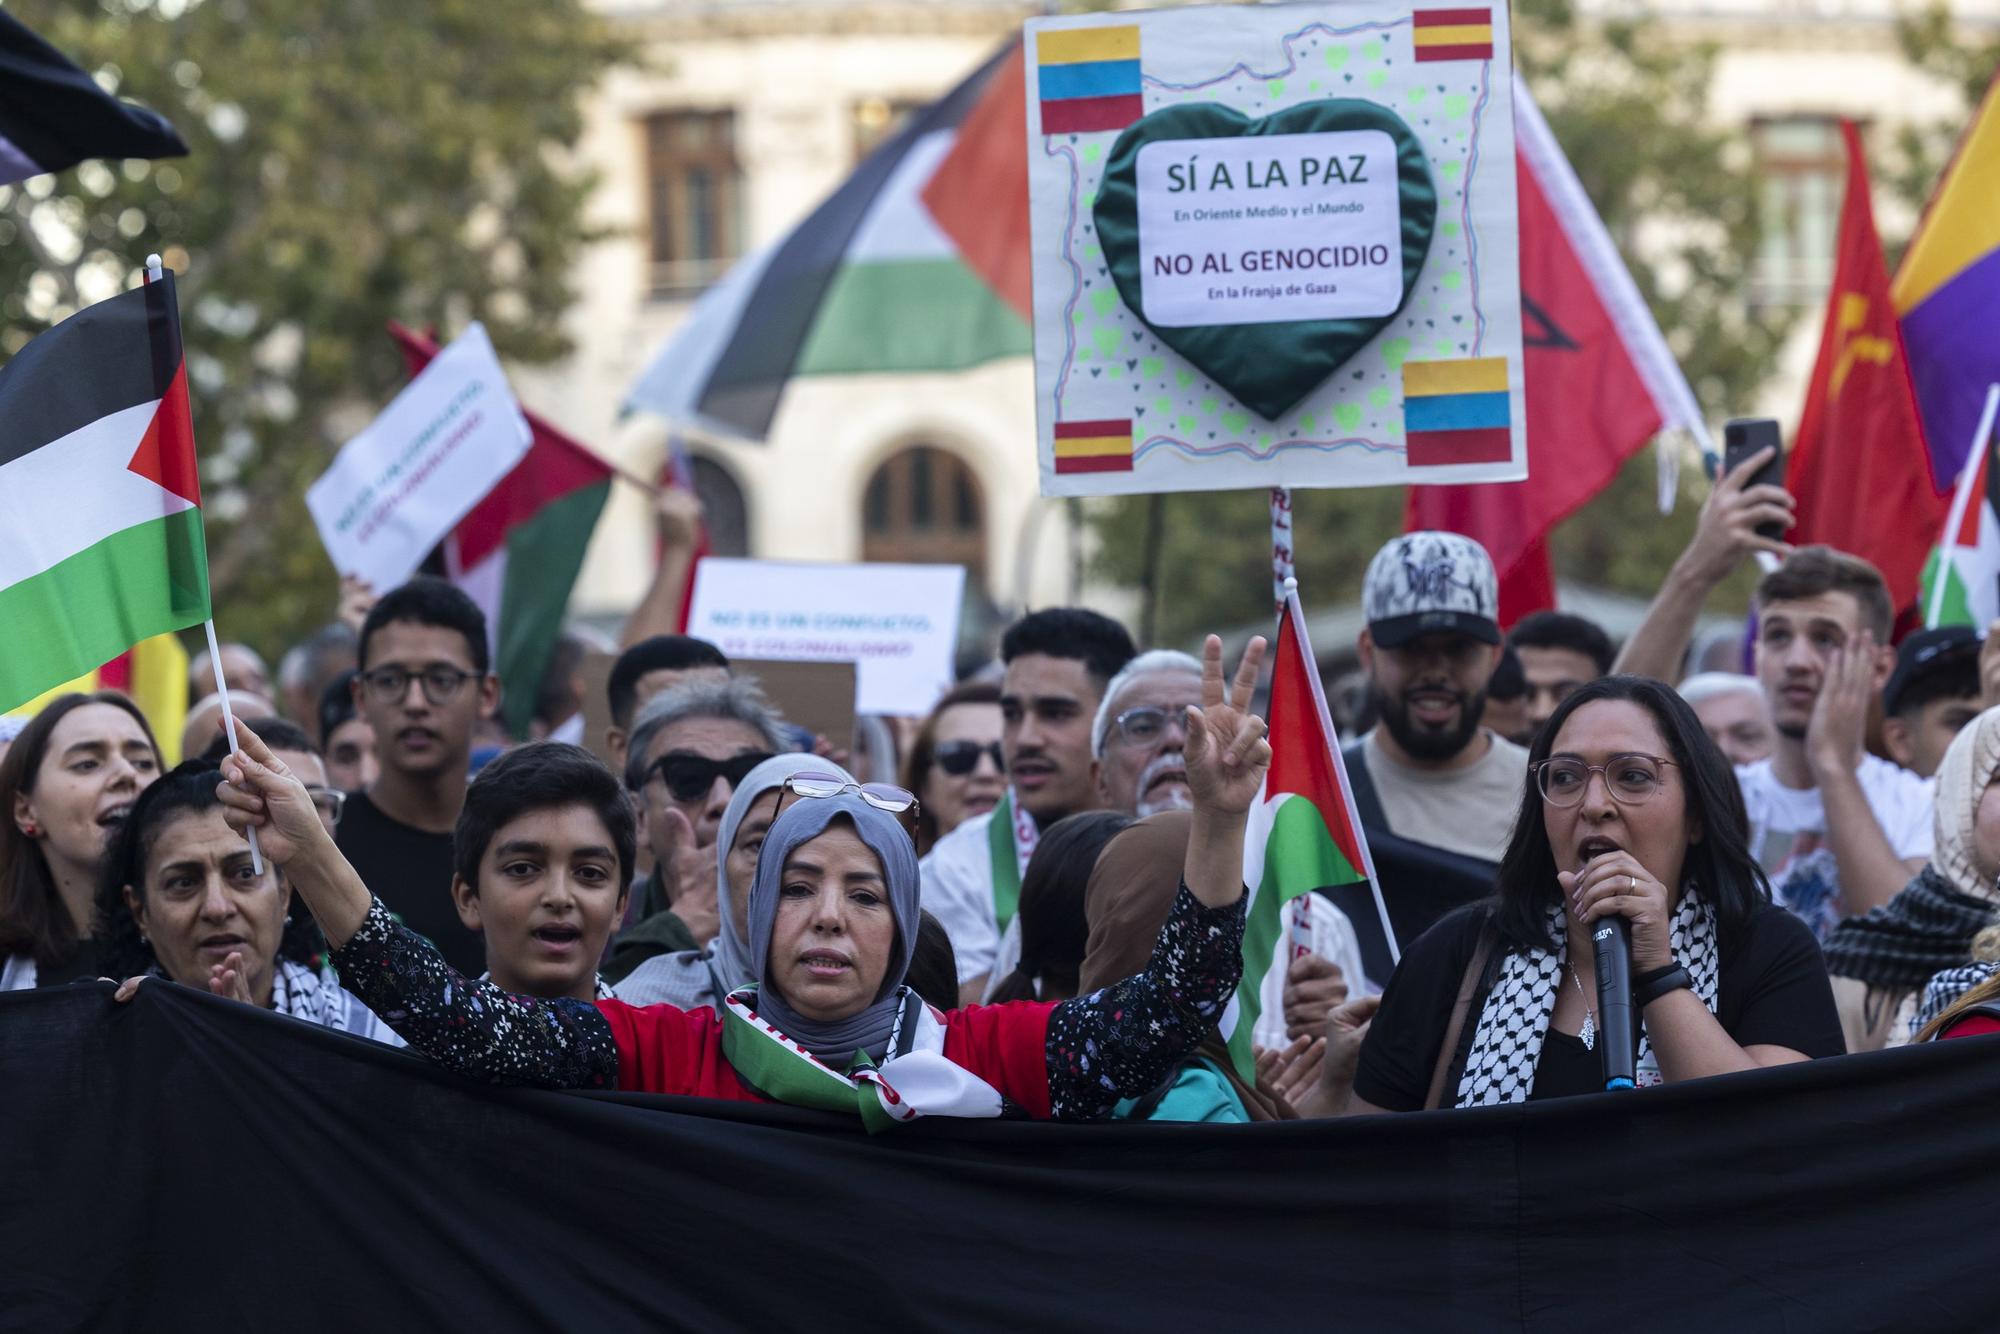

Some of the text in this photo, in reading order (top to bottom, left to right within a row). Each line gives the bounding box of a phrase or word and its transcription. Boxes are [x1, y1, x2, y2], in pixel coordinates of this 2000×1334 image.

[1167, 154, 1369, 193] SÍ A LA PAZ
[1173, 201, 1365, 222] En Oriente Medio y el Mundo
[1154, 244, 1390, 276] NO AL GENOCIDIO
[1207, 282, 1337, 300] En la Franja de Gaza
